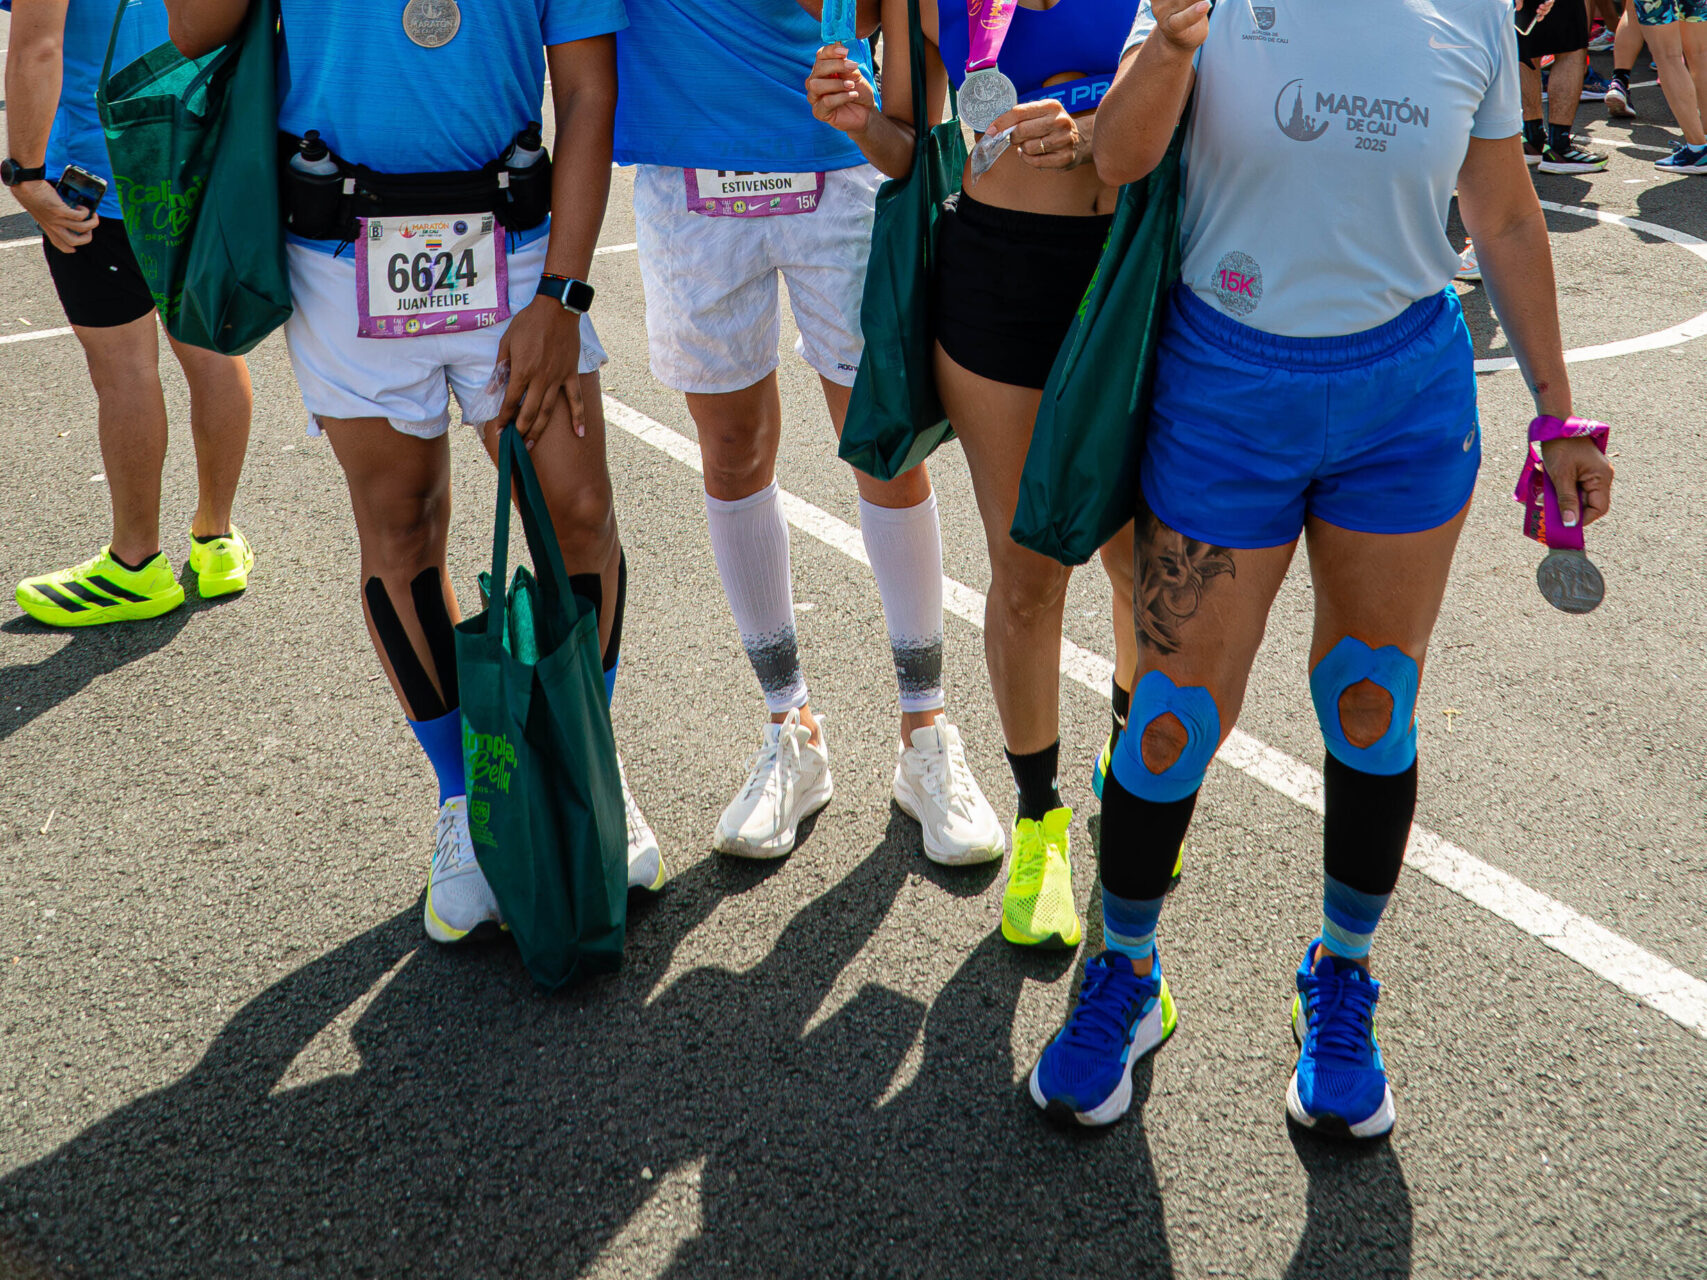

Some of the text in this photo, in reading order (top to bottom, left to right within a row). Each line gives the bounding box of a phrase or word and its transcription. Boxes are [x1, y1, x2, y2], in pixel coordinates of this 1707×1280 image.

[1242, 33, 1267, 41] SANTIAGO
[1315, 91, 1429, 128] MARATÓN
[1346, 117, 1397, 136] DE CALI
[1354, 136, 1387, 153] 2025
[722, 177, 792, 194] ESTIVENSON
[796, 193, 817, 210] 15K
[371, 226, 380, 238] B
[412, 220, 450, 231] MARATÓN
[387, 248, 478, 294] 6624
[1219, 269, 1256, 297] 15K
[396, 293, 470, 311] JUAN FELIPE
[474, 311, 497, 329] 15K
